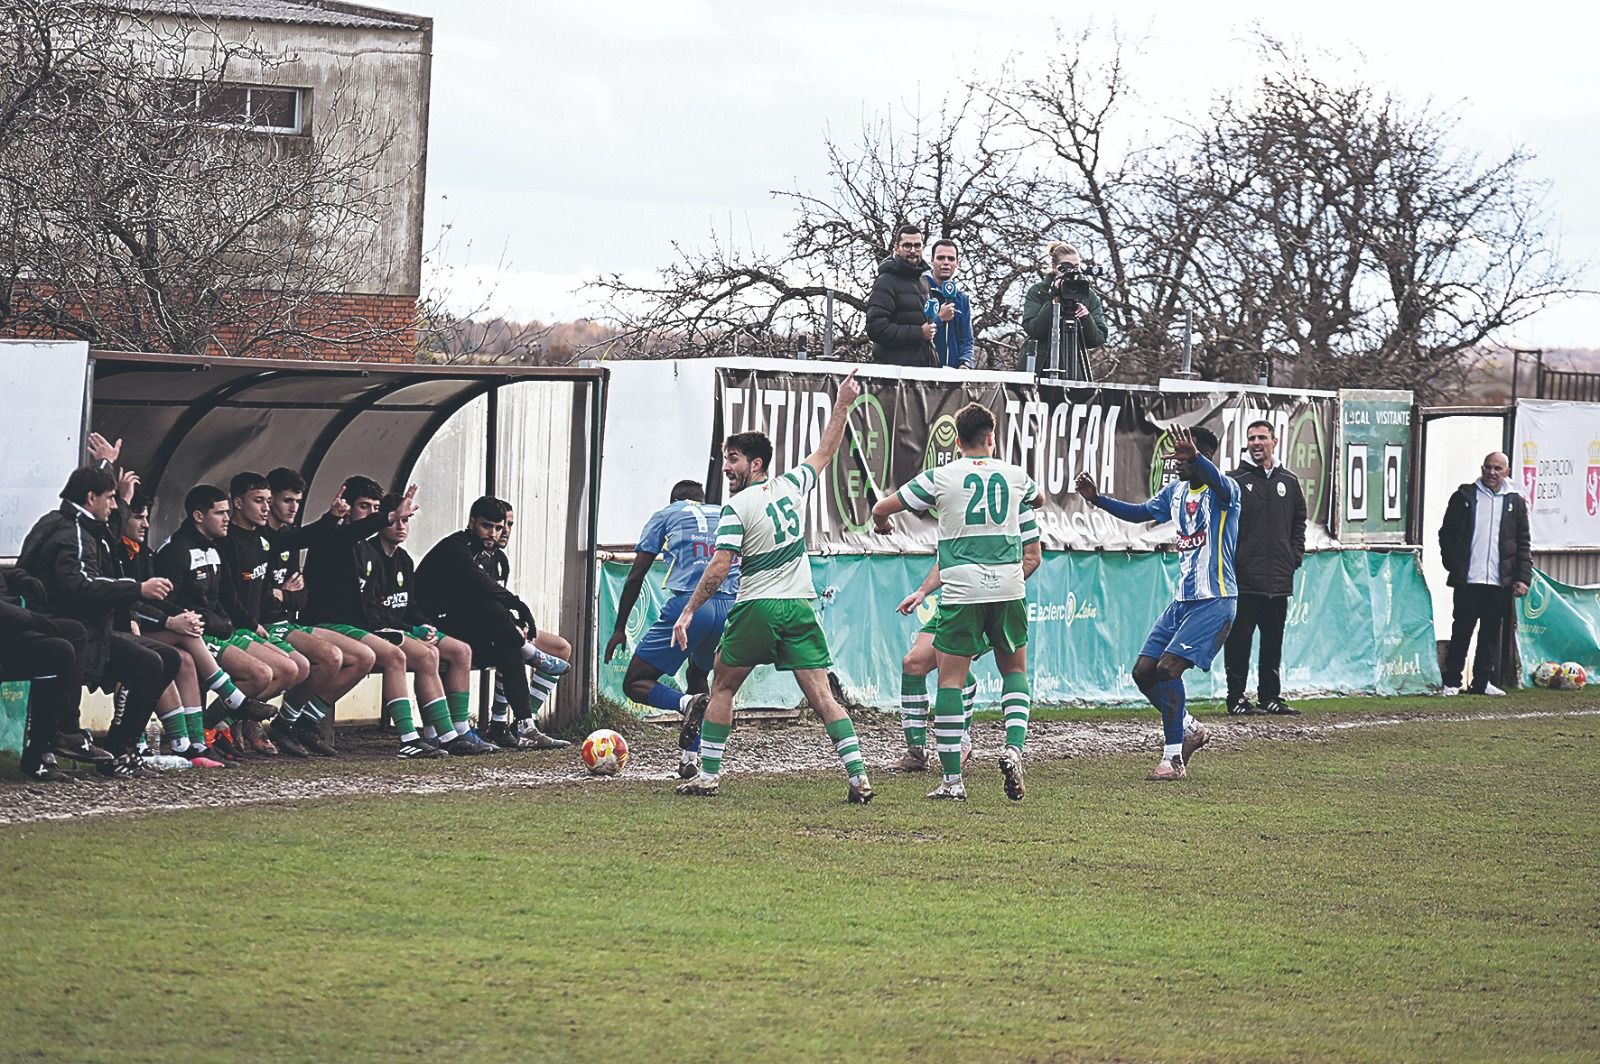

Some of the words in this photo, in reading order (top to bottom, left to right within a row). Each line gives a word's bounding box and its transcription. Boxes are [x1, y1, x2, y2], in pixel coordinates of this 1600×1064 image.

[1344, 410, 1371, 425] LOCAL
[1375, 411, 1411, 426] VISITANTE
[1004, 400, 1121, 494] TERCERA
[1296, 443, 1318, 468] RF
[963, 472, 1010, 525] 20
[1351, 456, 1364, 510] 0
[1387, 456, 1398, 509] 0
[765, 495, 800, 545] 15
